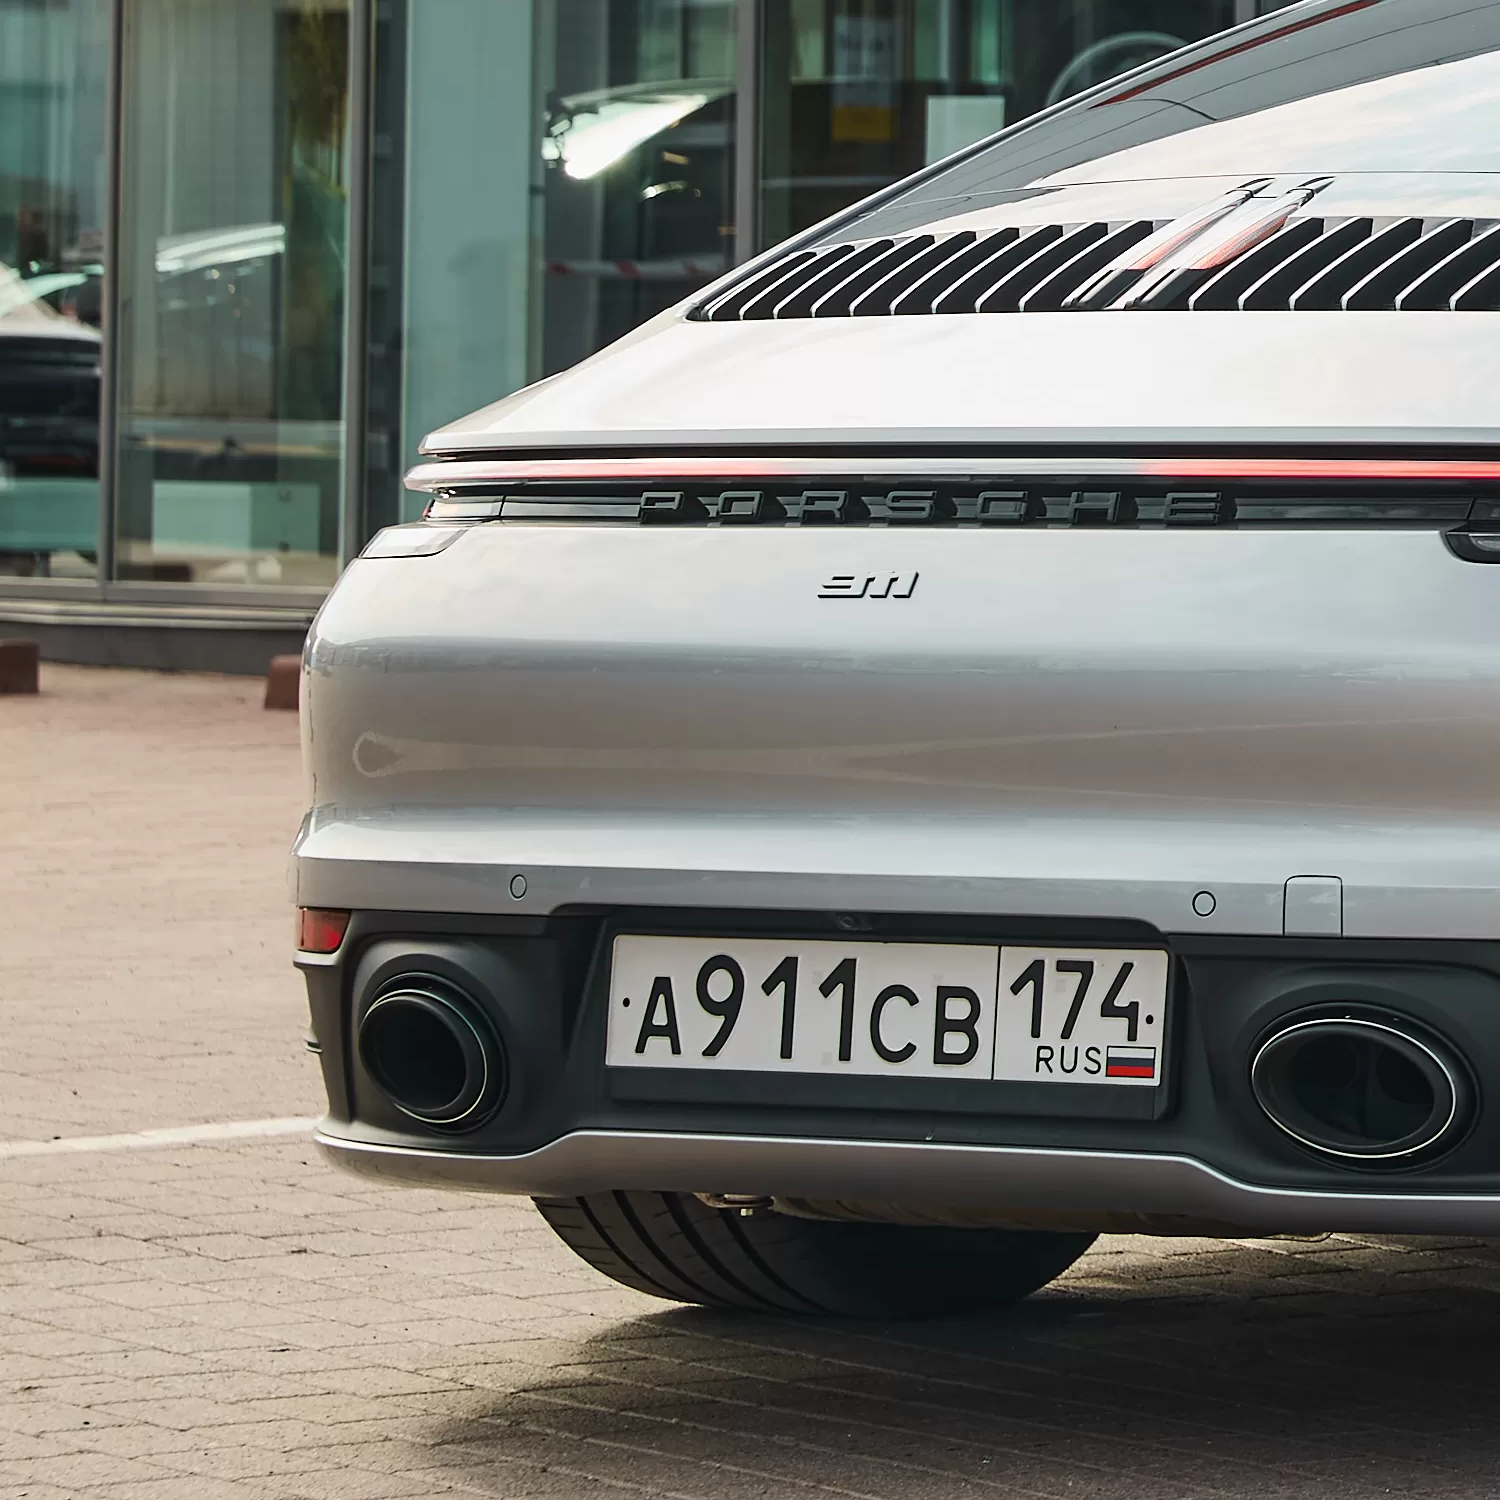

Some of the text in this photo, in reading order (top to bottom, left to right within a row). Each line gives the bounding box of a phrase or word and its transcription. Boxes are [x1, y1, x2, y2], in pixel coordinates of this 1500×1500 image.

[640, 490, 1222, 525] PORSCHE
[817, 569, 920, 599] 911
[1010, 959, 1139, 1041] 174
[1035, 1046, 1102, 1075] RUS
